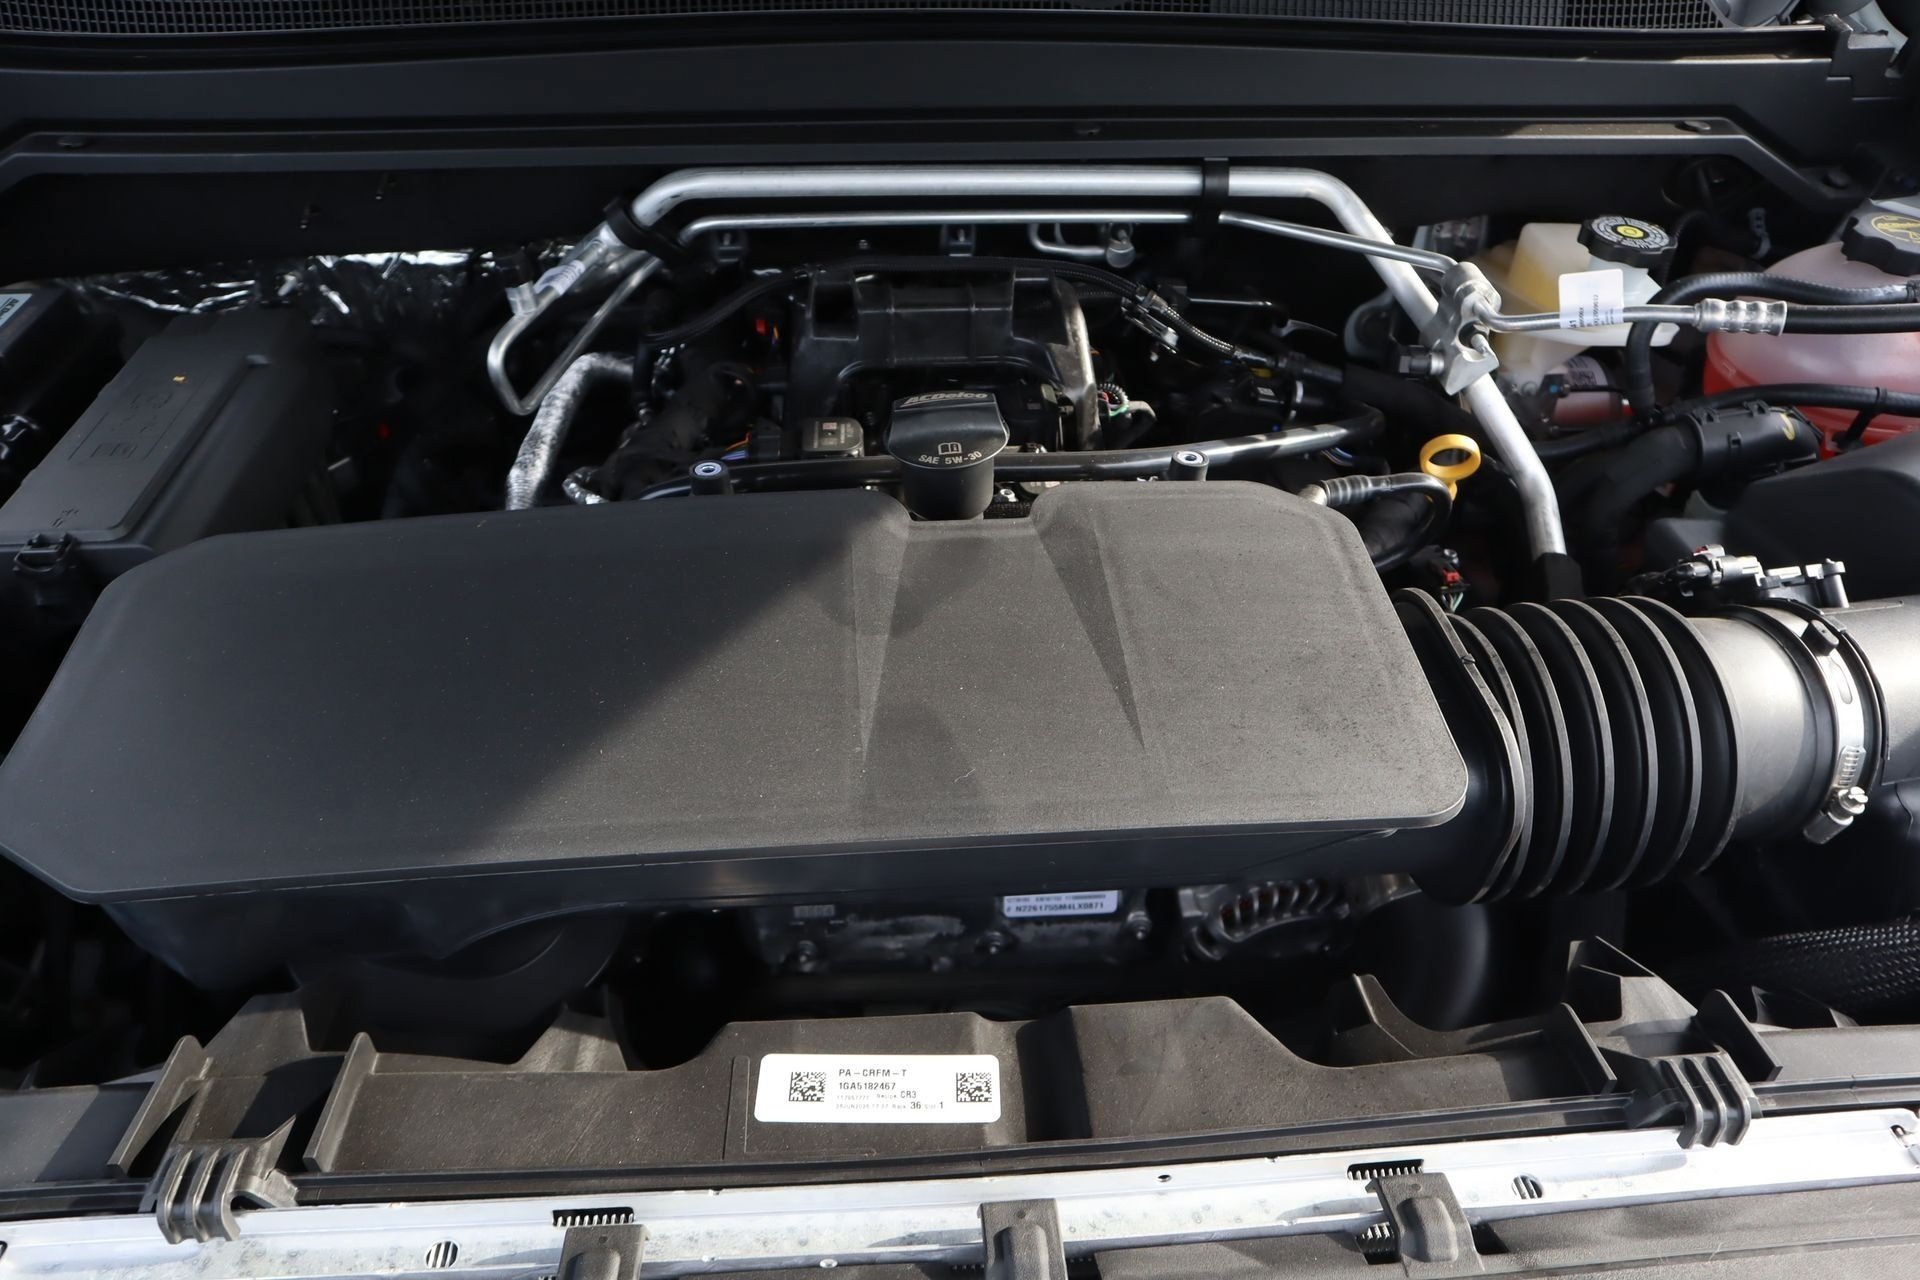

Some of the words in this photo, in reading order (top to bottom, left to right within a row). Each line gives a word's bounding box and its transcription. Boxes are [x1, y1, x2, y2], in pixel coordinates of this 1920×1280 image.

[902, 392, 988, 406] ACDelco
[918, 454, 939, 465] SAE
[944, 451, 982, 465] 5W-30
[839, 1081, 896, 1090] 1GA5182467
[900, 1090, 917, 1099] CR3
[910, 1101, 921, 1110] 36
[939, 1101, 944, 1110] 1
